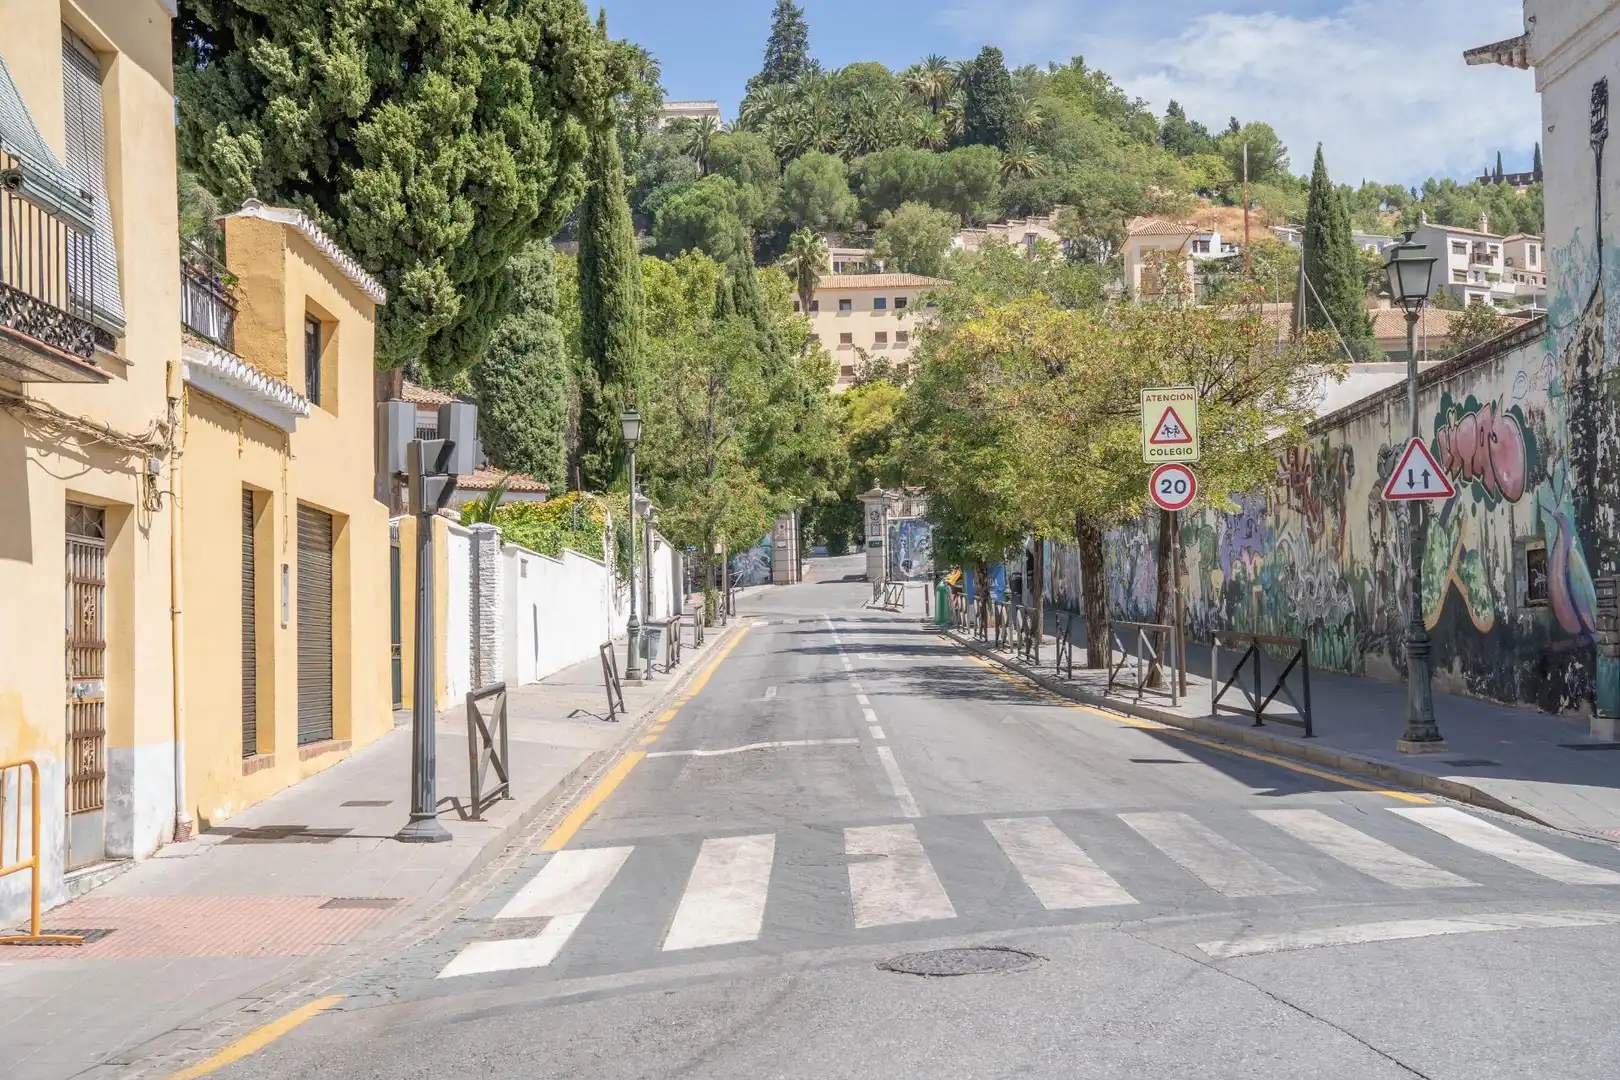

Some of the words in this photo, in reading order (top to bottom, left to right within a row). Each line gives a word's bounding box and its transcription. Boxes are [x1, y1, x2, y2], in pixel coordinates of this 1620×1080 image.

[1145, 392, 1193, 402] ATENCIÓN
[1149, 447, 1193, 456] COLEGIO
[1161, 479, 1187, 494] 20
